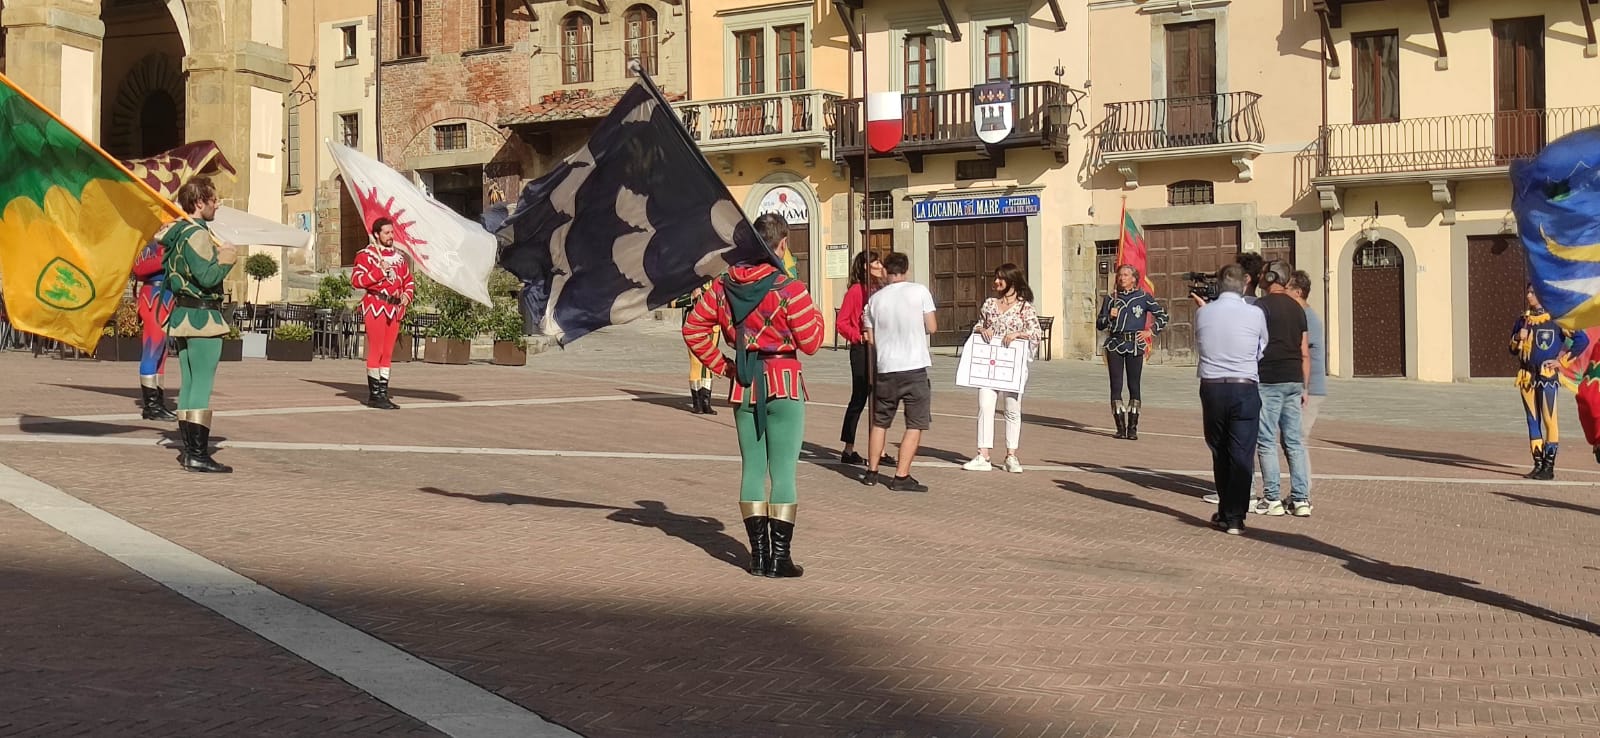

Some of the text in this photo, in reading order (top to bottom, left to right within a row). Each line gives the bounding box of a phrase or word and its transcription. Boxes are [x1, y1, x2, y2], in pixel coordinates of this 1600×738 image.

[916, 203, 926, 218] LA
[928, 201, 963, 217] LOCANDA
[976, 199, 1000, 215] MARE
